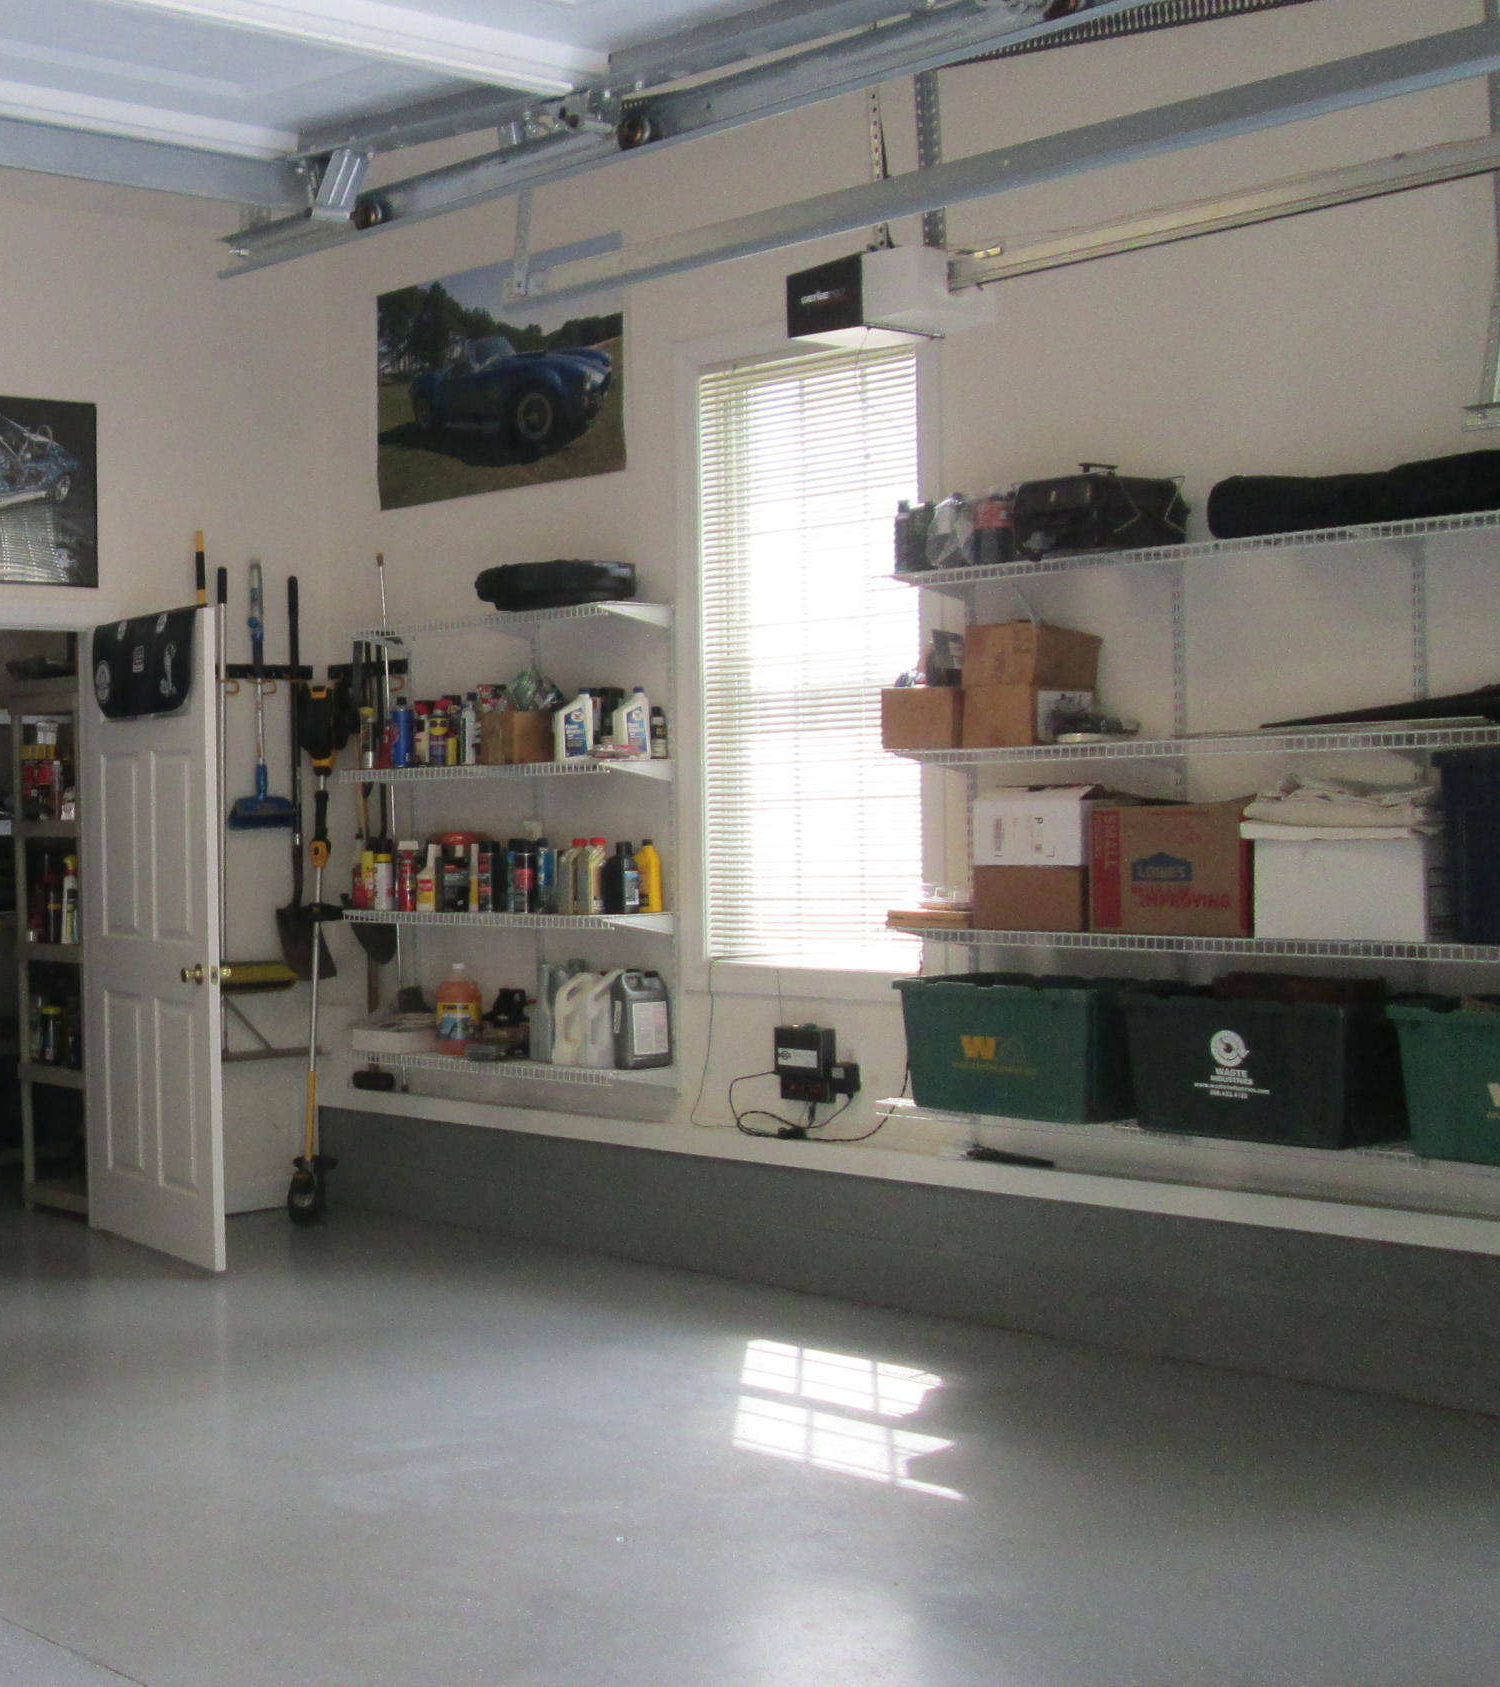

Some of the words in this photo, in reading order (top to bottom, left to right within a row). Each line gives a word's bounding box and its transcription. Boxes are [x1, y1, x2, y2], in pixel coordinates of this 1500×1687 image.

[1102, 813, 1118, 871] SMALL
[1136, 864, 1187, 879] LOWES
[1141, 893, 1231, 908] IMPROVING
[1215, 1067, 1248, 1078] WASTE
